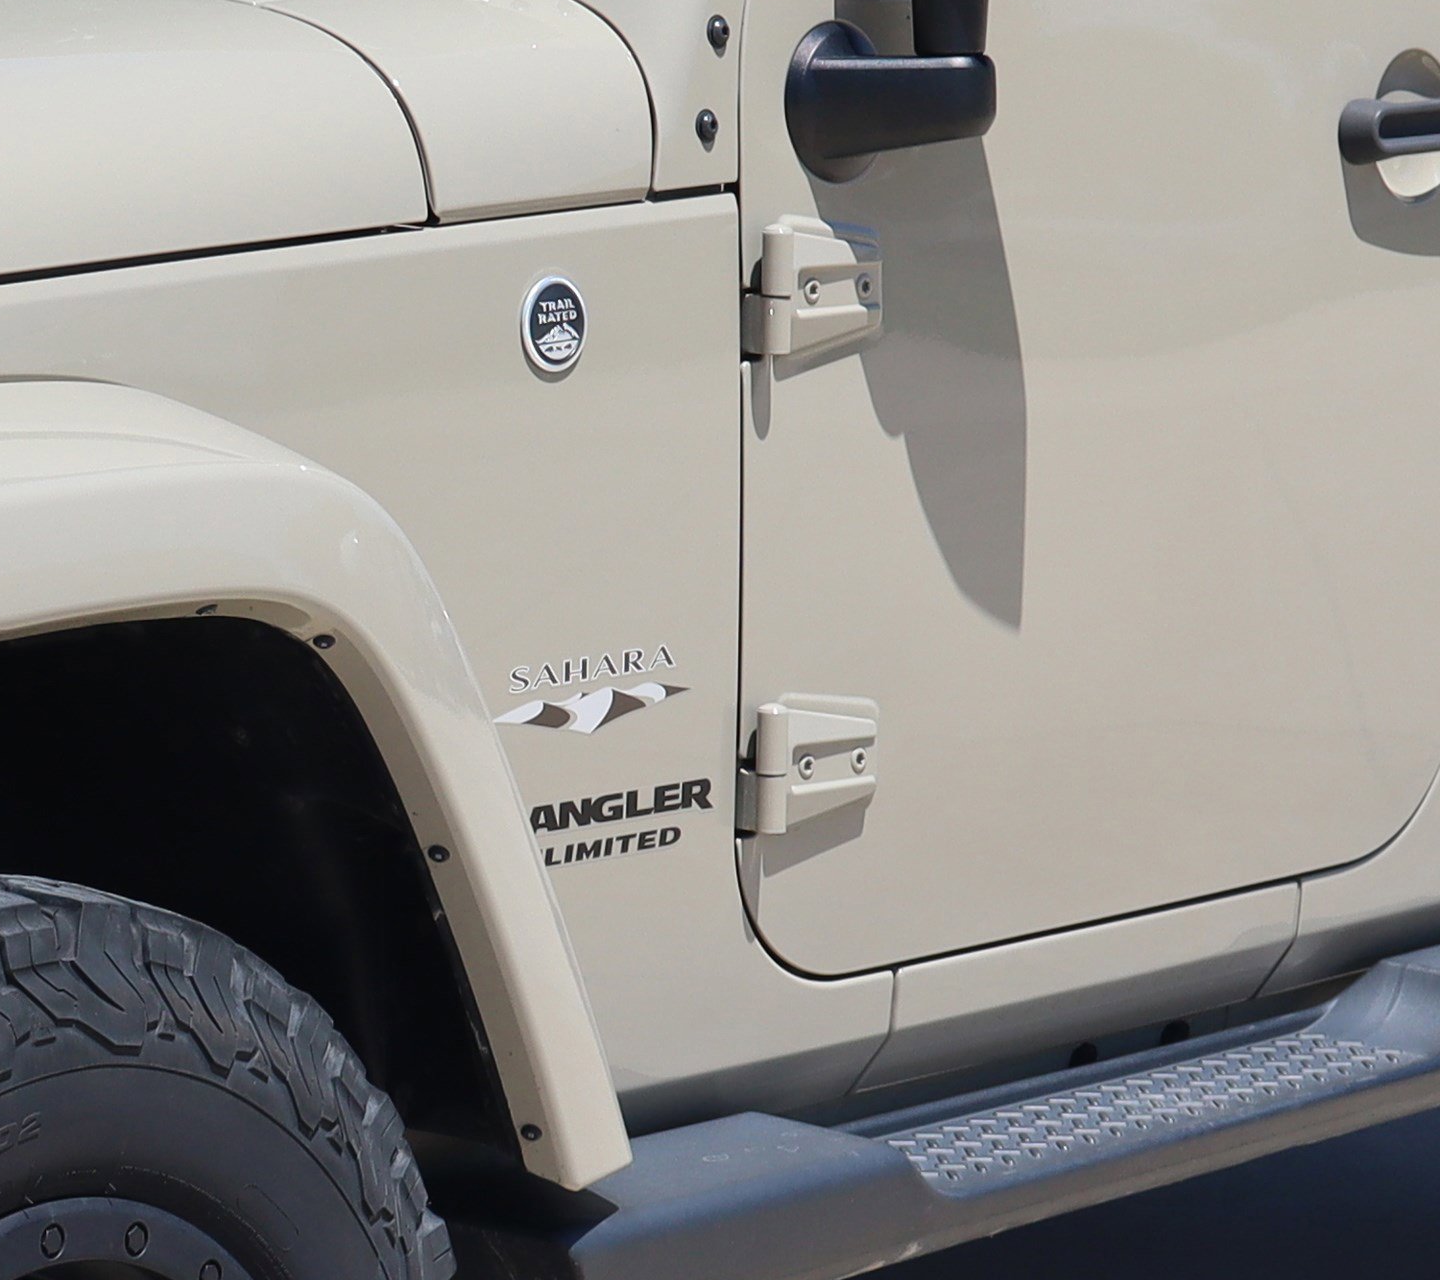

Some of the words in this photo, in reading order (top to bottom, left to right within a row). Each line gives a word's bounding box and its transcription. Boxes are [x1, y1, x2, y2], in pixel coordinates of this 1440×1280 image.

[537, 310, 577, 324] RATED
[539, 298, 575, 312] TRAIL
[509, 642, 676, 694] SAHARA
[529, 778, 714, 833] ANGLER
[543, 826, 681, 867] LIMITED
